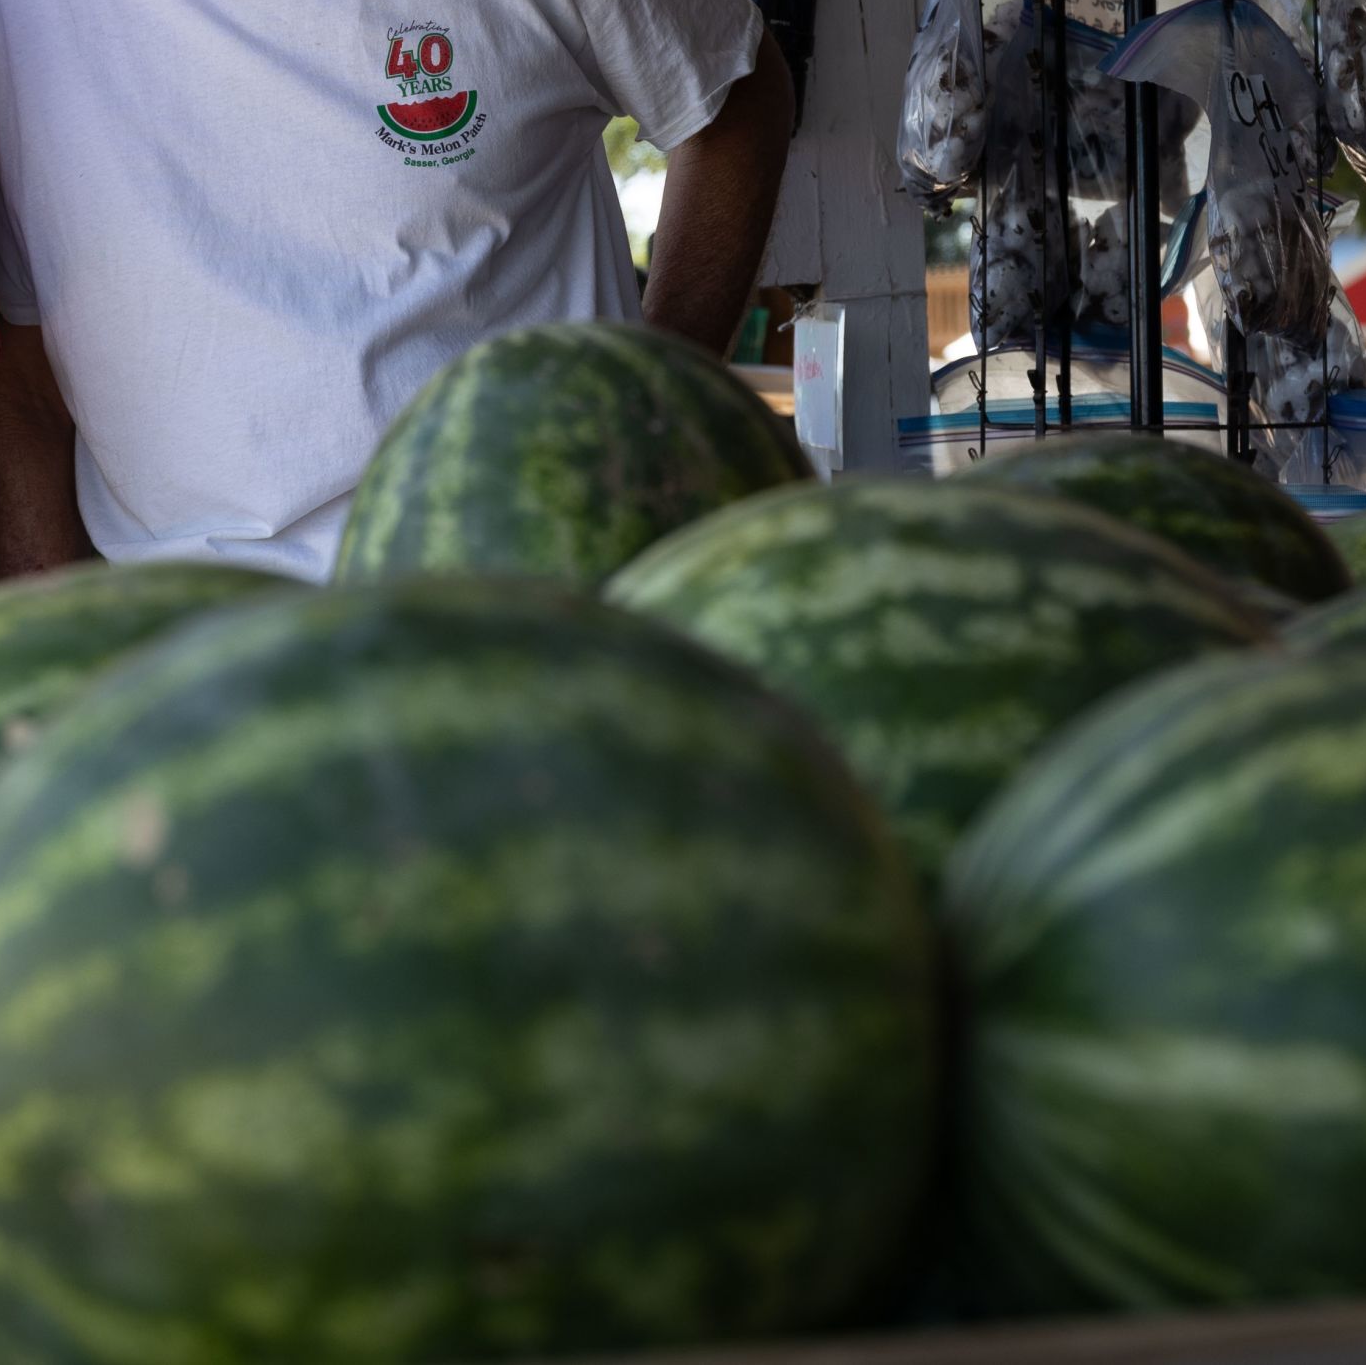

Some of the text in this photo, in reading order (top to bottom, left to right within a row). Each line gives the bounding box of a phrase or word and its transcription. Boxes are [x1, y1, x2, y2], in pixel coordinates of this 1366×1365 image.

[387, 20, 451, 42] Celebrating
[385, 32, 453, 82] 40
[397, 76, 453, 98] YEARS
[375, 112, 487, 155] Mark's Melon Patch
[404, 147, 476, 168] Sasser, Georgia
